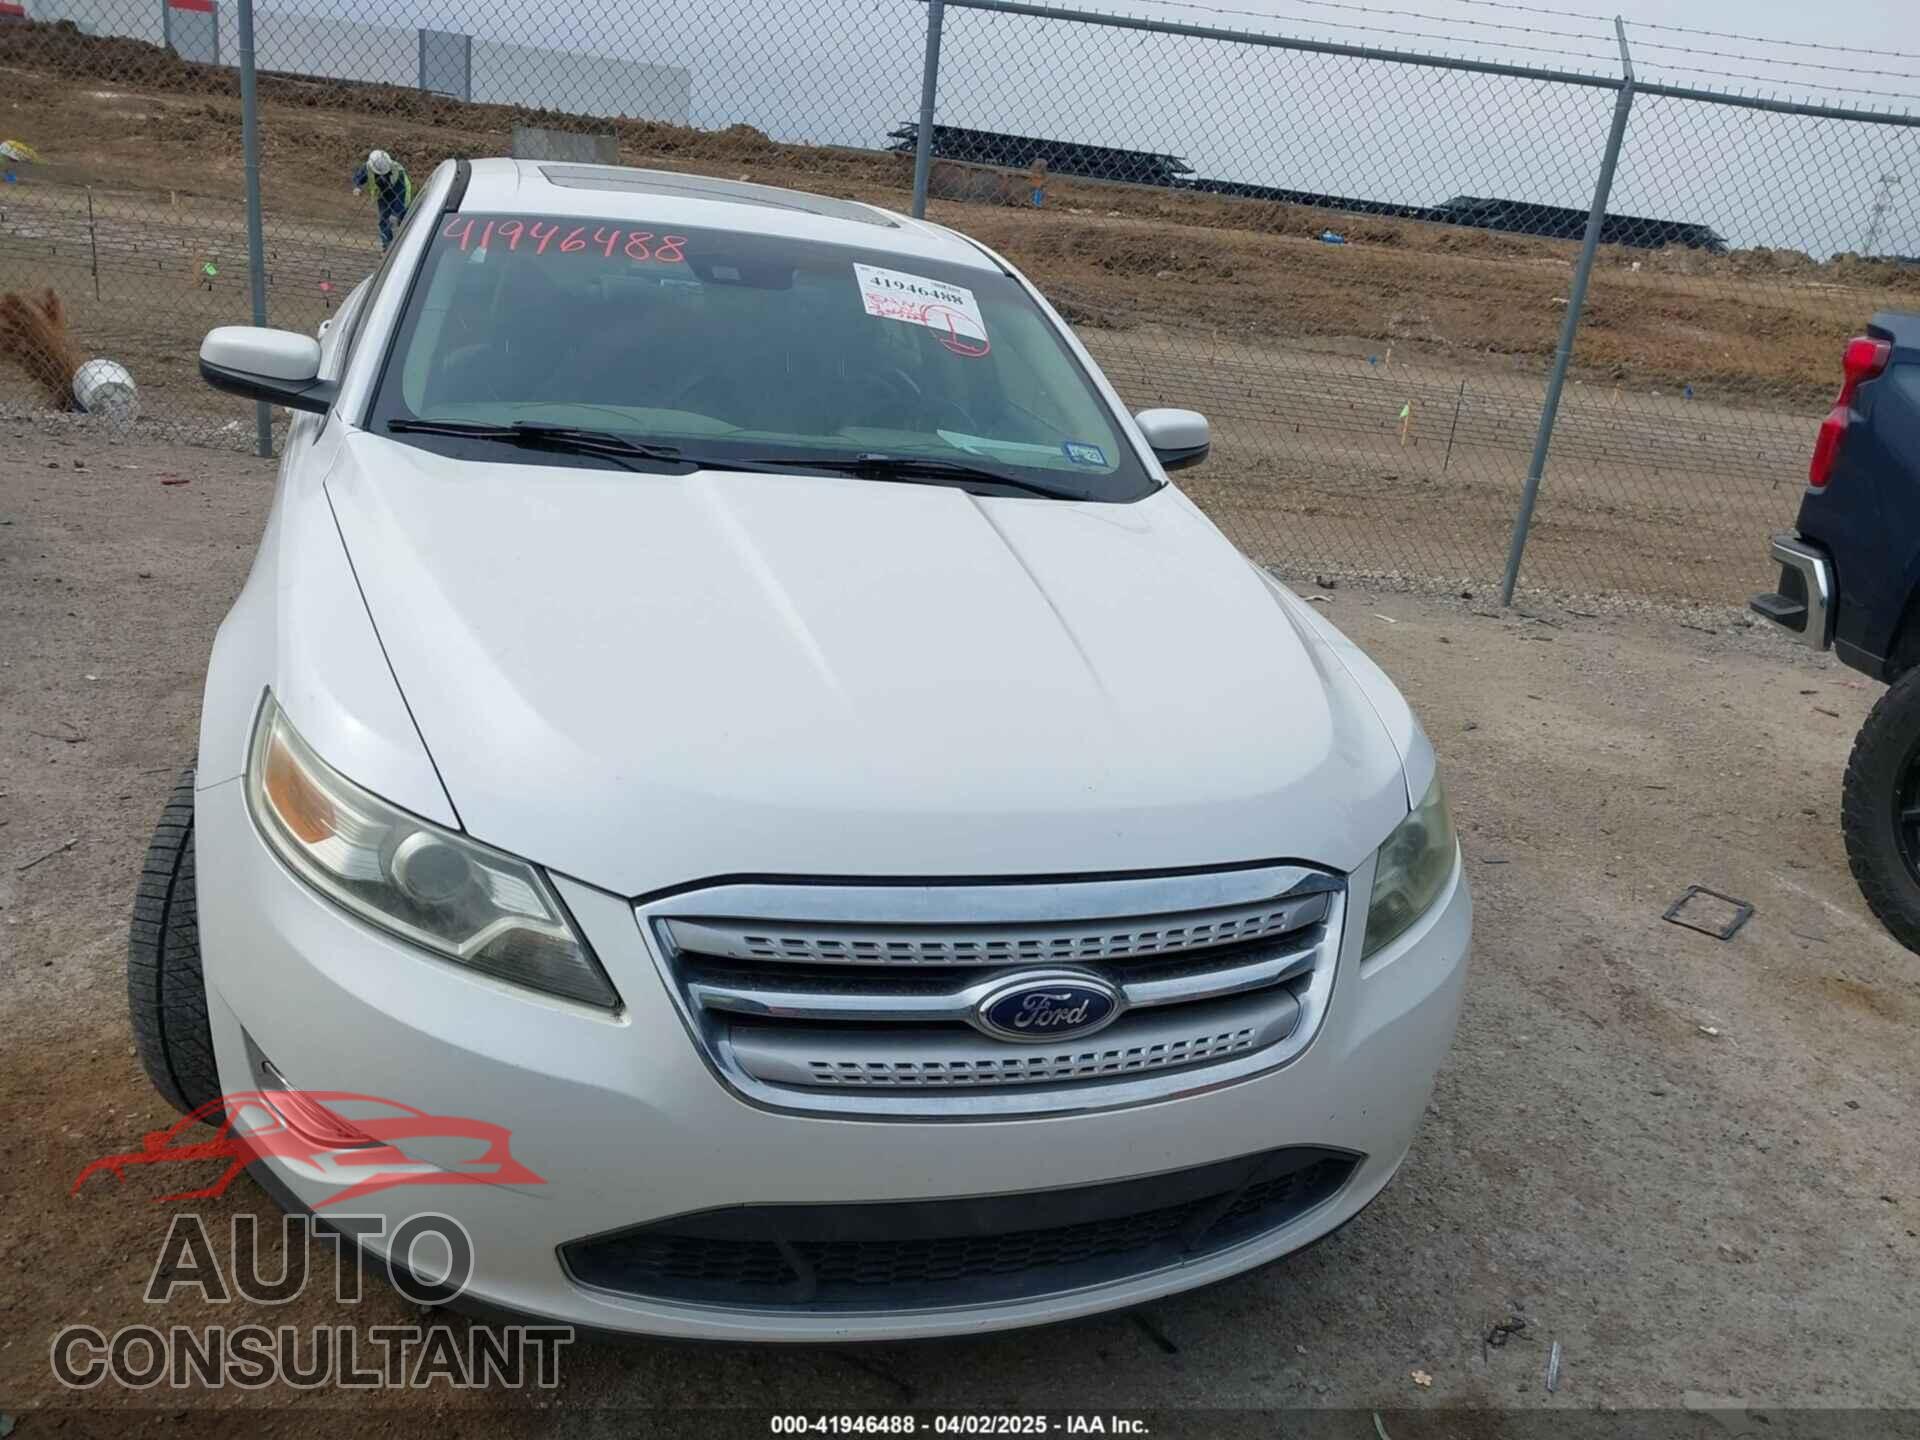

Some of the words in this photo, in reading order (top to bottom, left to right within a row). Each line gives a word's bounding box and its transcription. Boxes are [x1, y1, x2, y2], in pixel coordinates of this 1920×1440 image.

[442, 217, 689, 263] 41946488
[870, 276, 964, 305] 41946488
[1013, 992, 1090, 1028] Ford
